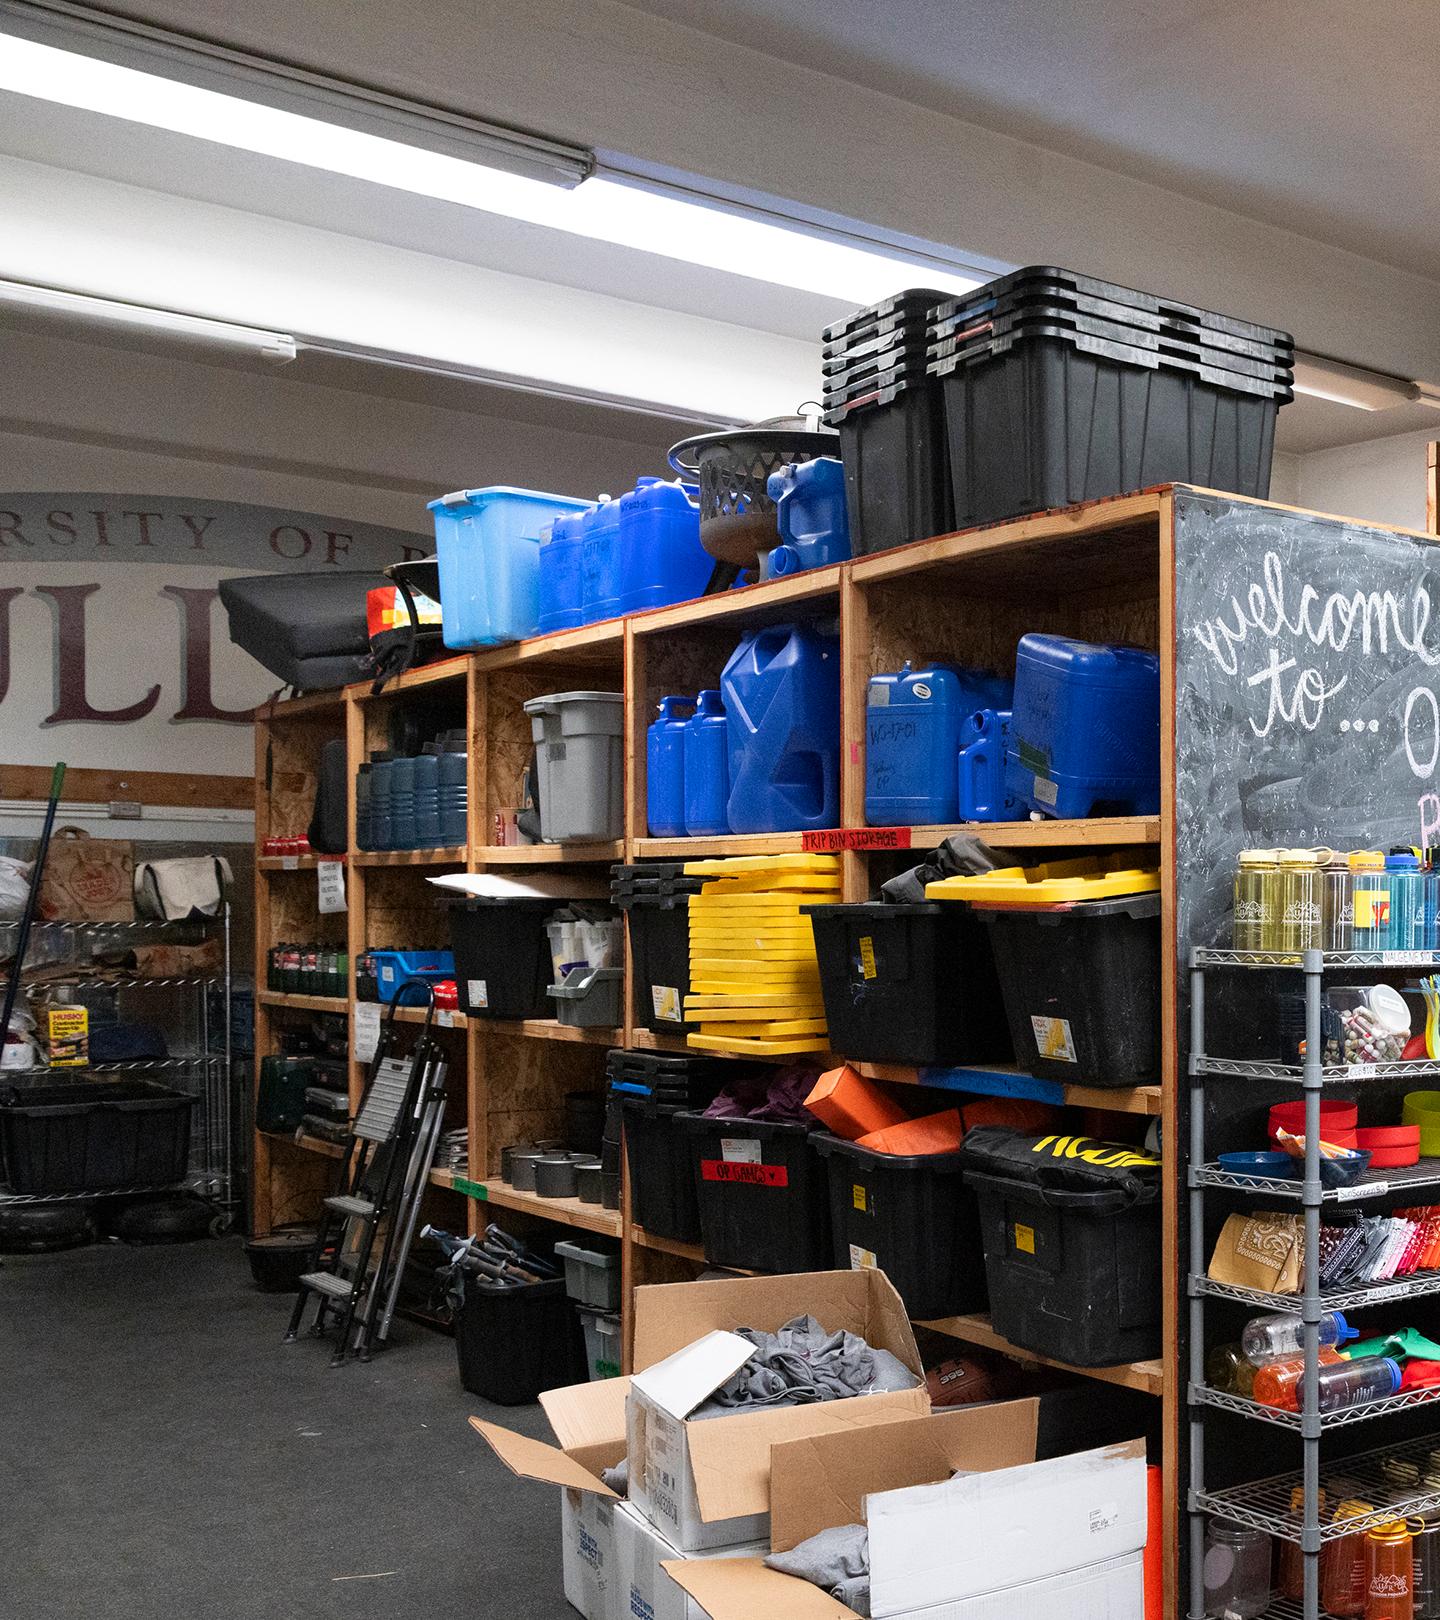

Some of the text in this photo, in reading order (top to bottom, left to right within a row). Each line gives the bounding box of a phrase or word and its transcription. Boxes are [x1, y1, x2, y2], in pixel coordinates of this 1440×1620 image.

[269, 525, 353, 564] OF
[803, 831, 898, 849] TRIP BIN STORAGE
[717, 1164, 766, 1183] OP GAMES
[940, 1368, 965, 1386] 395
